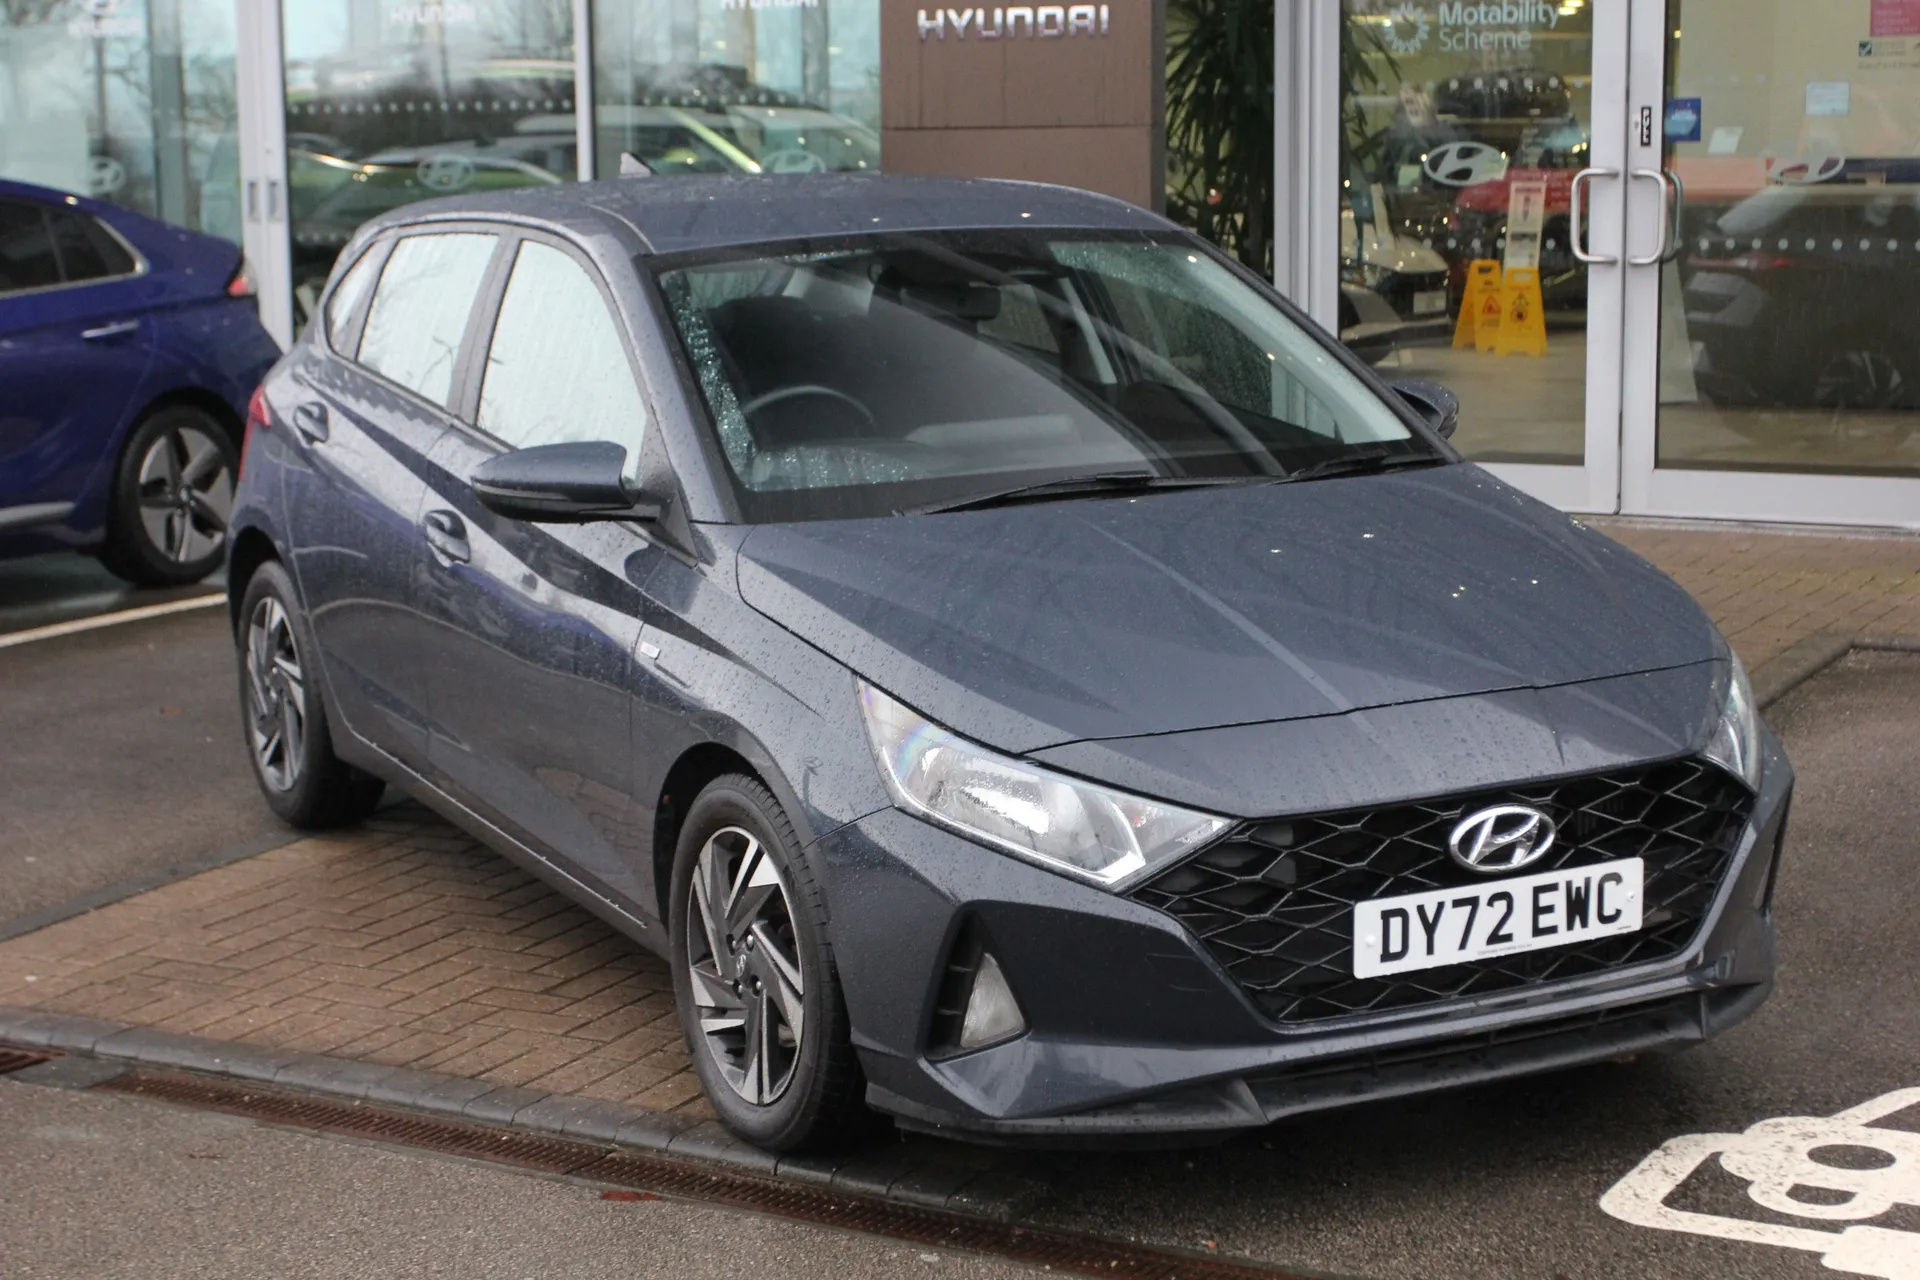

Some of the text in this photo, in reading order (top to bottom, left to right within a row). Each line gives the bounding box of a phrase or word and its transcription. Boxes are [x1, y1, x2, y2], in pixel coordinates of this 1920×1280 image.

[917, 4, 1109, 40] HYUNDAI
[1439, 0, 1560, 28] Motability
[1440, 28, 1532, 51] Scheme
[1379, 871, 1623, 963] DY72 EWC
